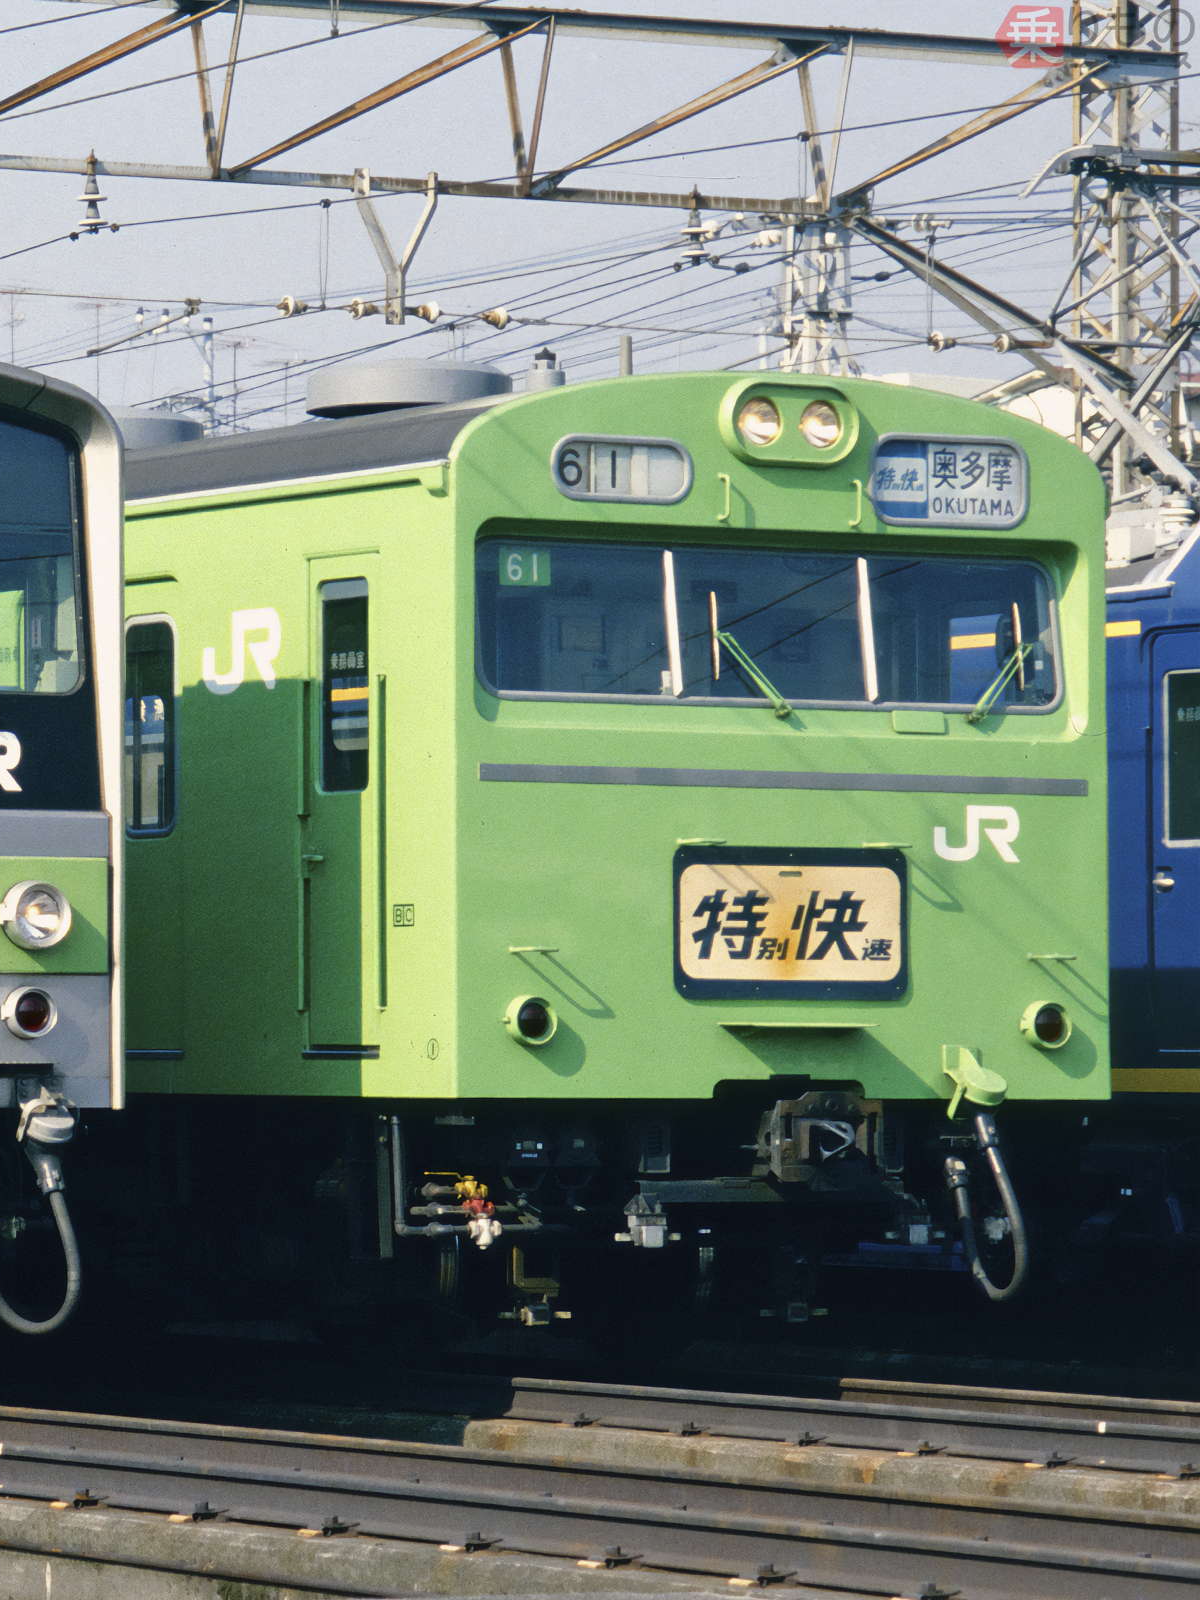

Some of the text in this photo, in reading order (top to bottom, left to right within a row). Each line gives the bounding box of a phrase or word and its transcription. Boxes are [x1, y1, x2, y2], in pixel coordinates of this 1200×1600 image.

[932, 448, 1013, 491] 奥多摩
[932, 496, 1014, 517] OKUTAMA
[506, 552, 539, 583] 61
[202, 606, 282, 695] JR
[933, 804, 1021, 864] JR
